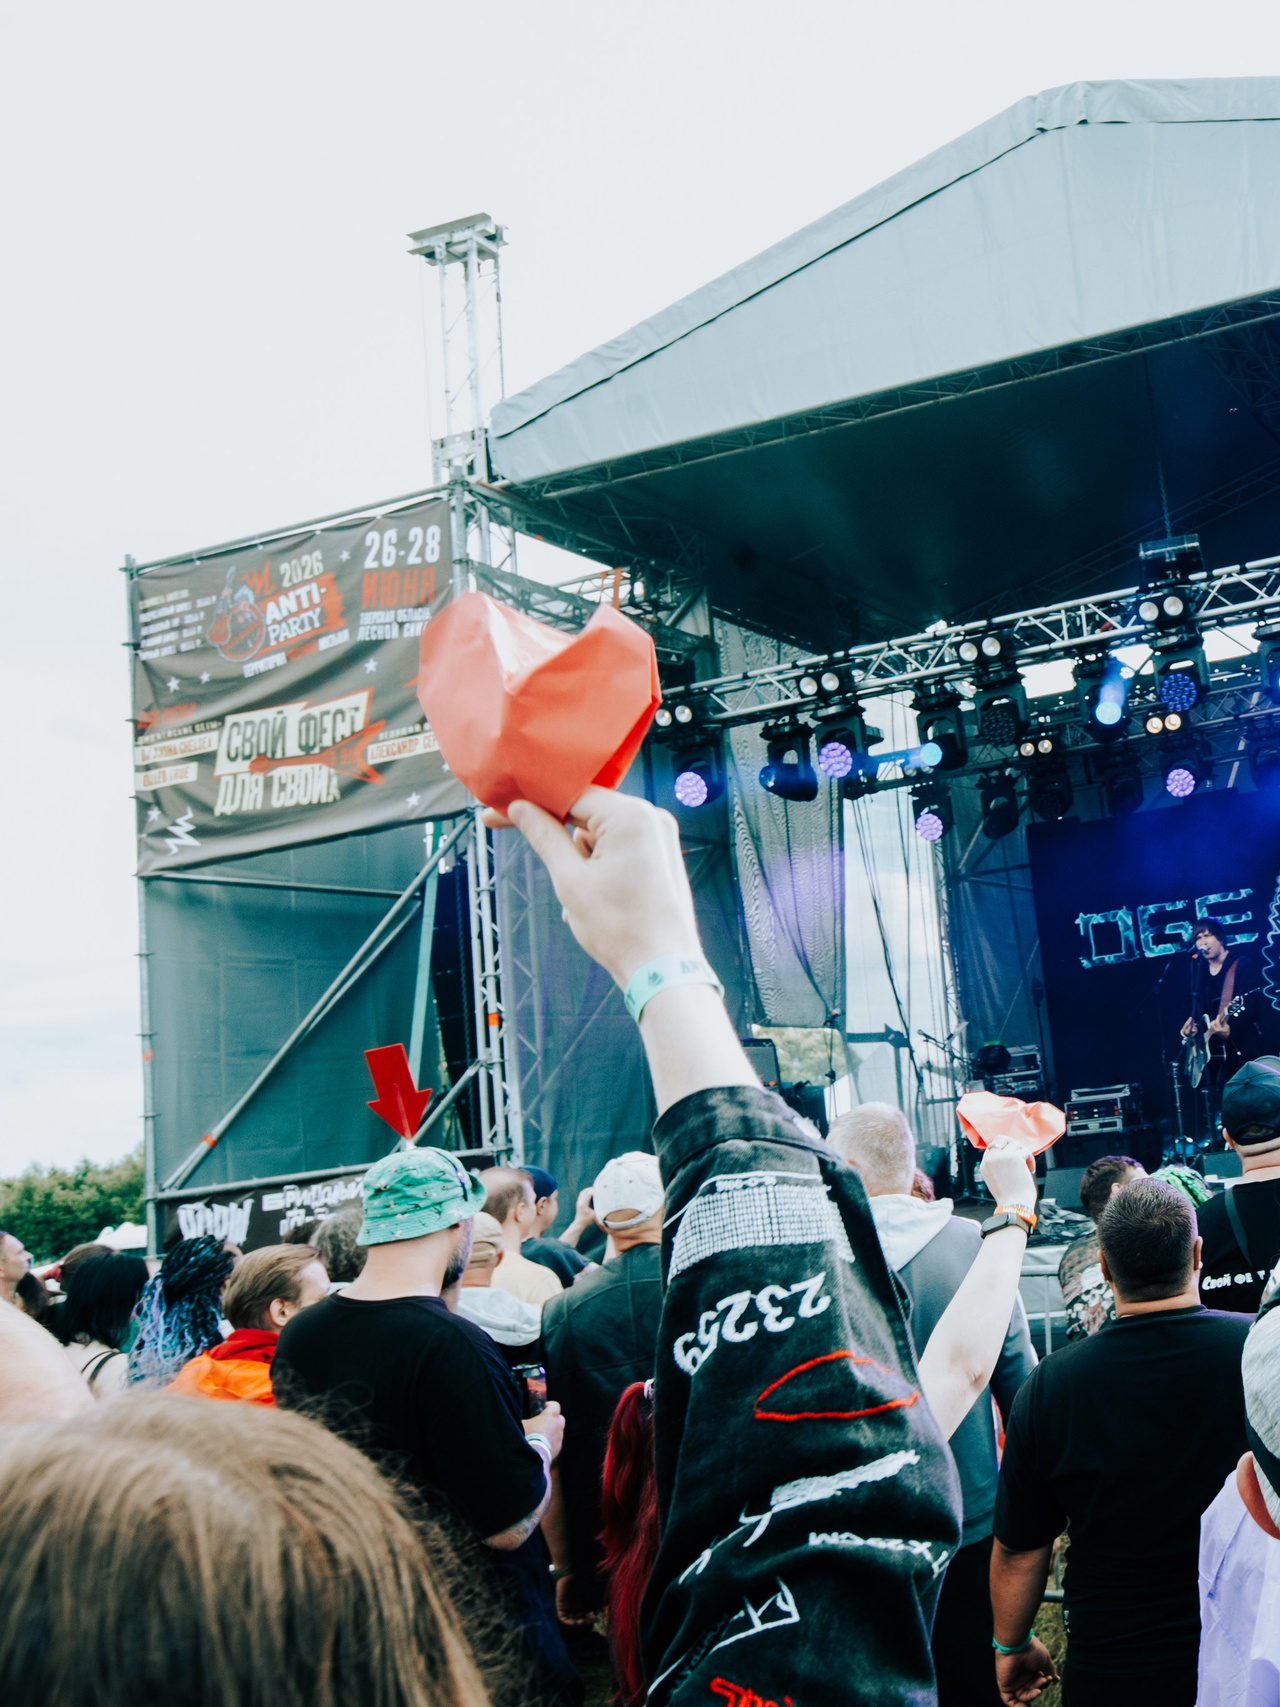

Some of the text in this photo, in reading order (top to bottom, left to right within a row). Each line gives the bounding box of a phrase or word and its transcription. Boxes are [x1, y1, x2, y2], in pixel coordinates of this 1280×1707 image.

[280, 550, 324, 587] 2026
[363, 525, 441, 569] 26-28
[266, 582, 327, 625] ANTI-
[361, 566, 435, 610] ИЮНЯ
[267, 607, 321, 646] PARTY
[227, 710, 288, 762] СВОЙ
[299, 706, 360, 753] ФЕСТ
[213, 773, 264, 817] ДЛЯ
